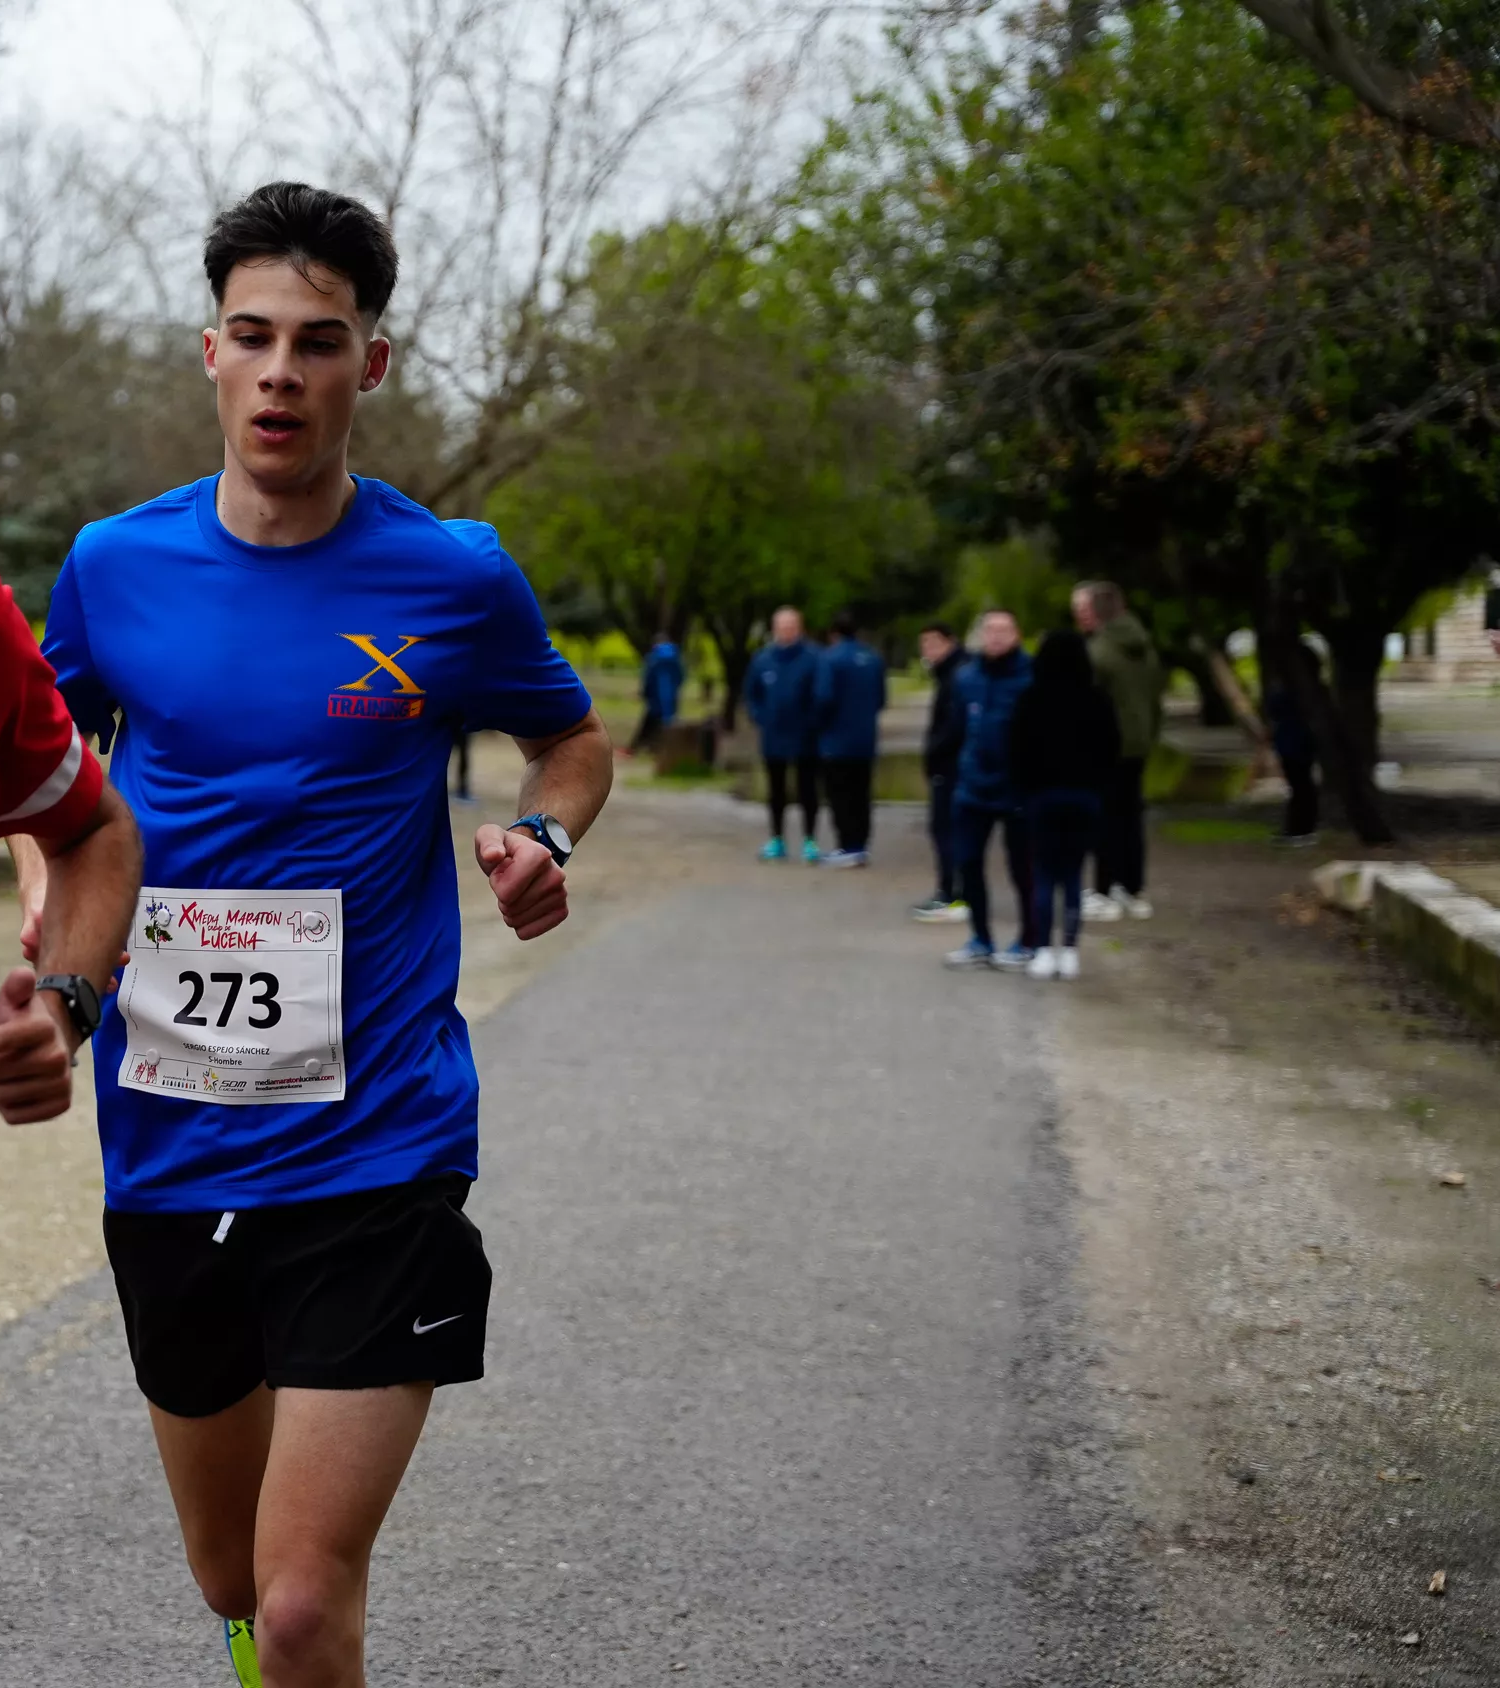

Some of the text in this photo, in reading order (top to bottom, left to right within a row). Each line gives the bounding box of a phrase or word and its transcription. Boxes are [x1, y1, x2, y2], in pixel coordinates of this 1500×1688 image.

[335, 633, 427, 694] X
[330, 697, 410, 717] TRAINING
[225, 909, 283, 926] MARATÓN
[200, 926, 269, 951] LUCENA
[173, 970, 282, 1029] 273
[182, 1042, 271, 1056] SERGIO ESPEJO SÁNCHEZ
[208, 1055, 243, 1066] S-Hombre
[254, 1075, 335, 1086] mediamaratonlucena.com
